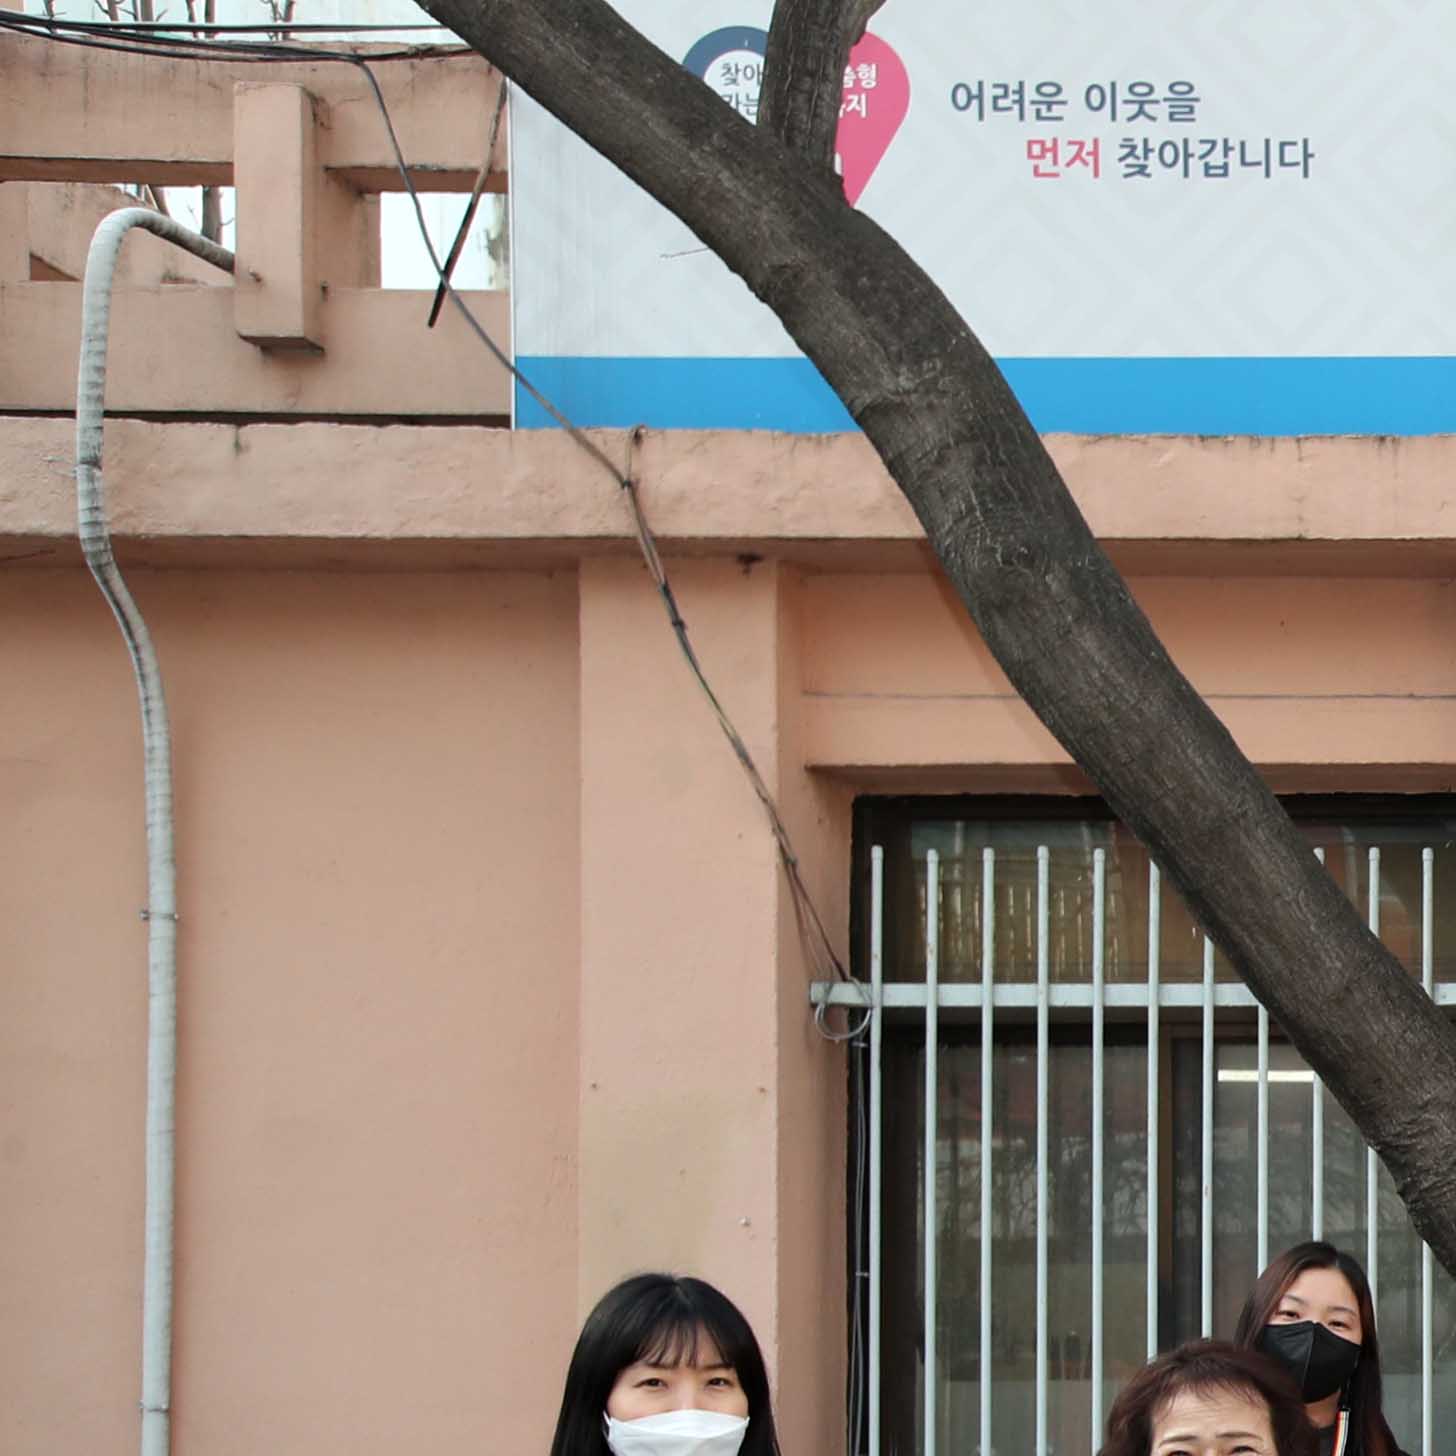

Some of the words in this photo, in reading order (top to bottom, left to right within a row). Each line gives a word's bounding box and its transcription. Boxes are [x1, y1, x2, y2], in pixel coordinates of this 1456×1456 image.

[950, 80, 1068, 122] 어려운
[1084, 81, 1201, 123] 이웃을
[1026, 139, 1102, 178] 먼저
[1117, 137, 1315, 179] 찾아갑니다
